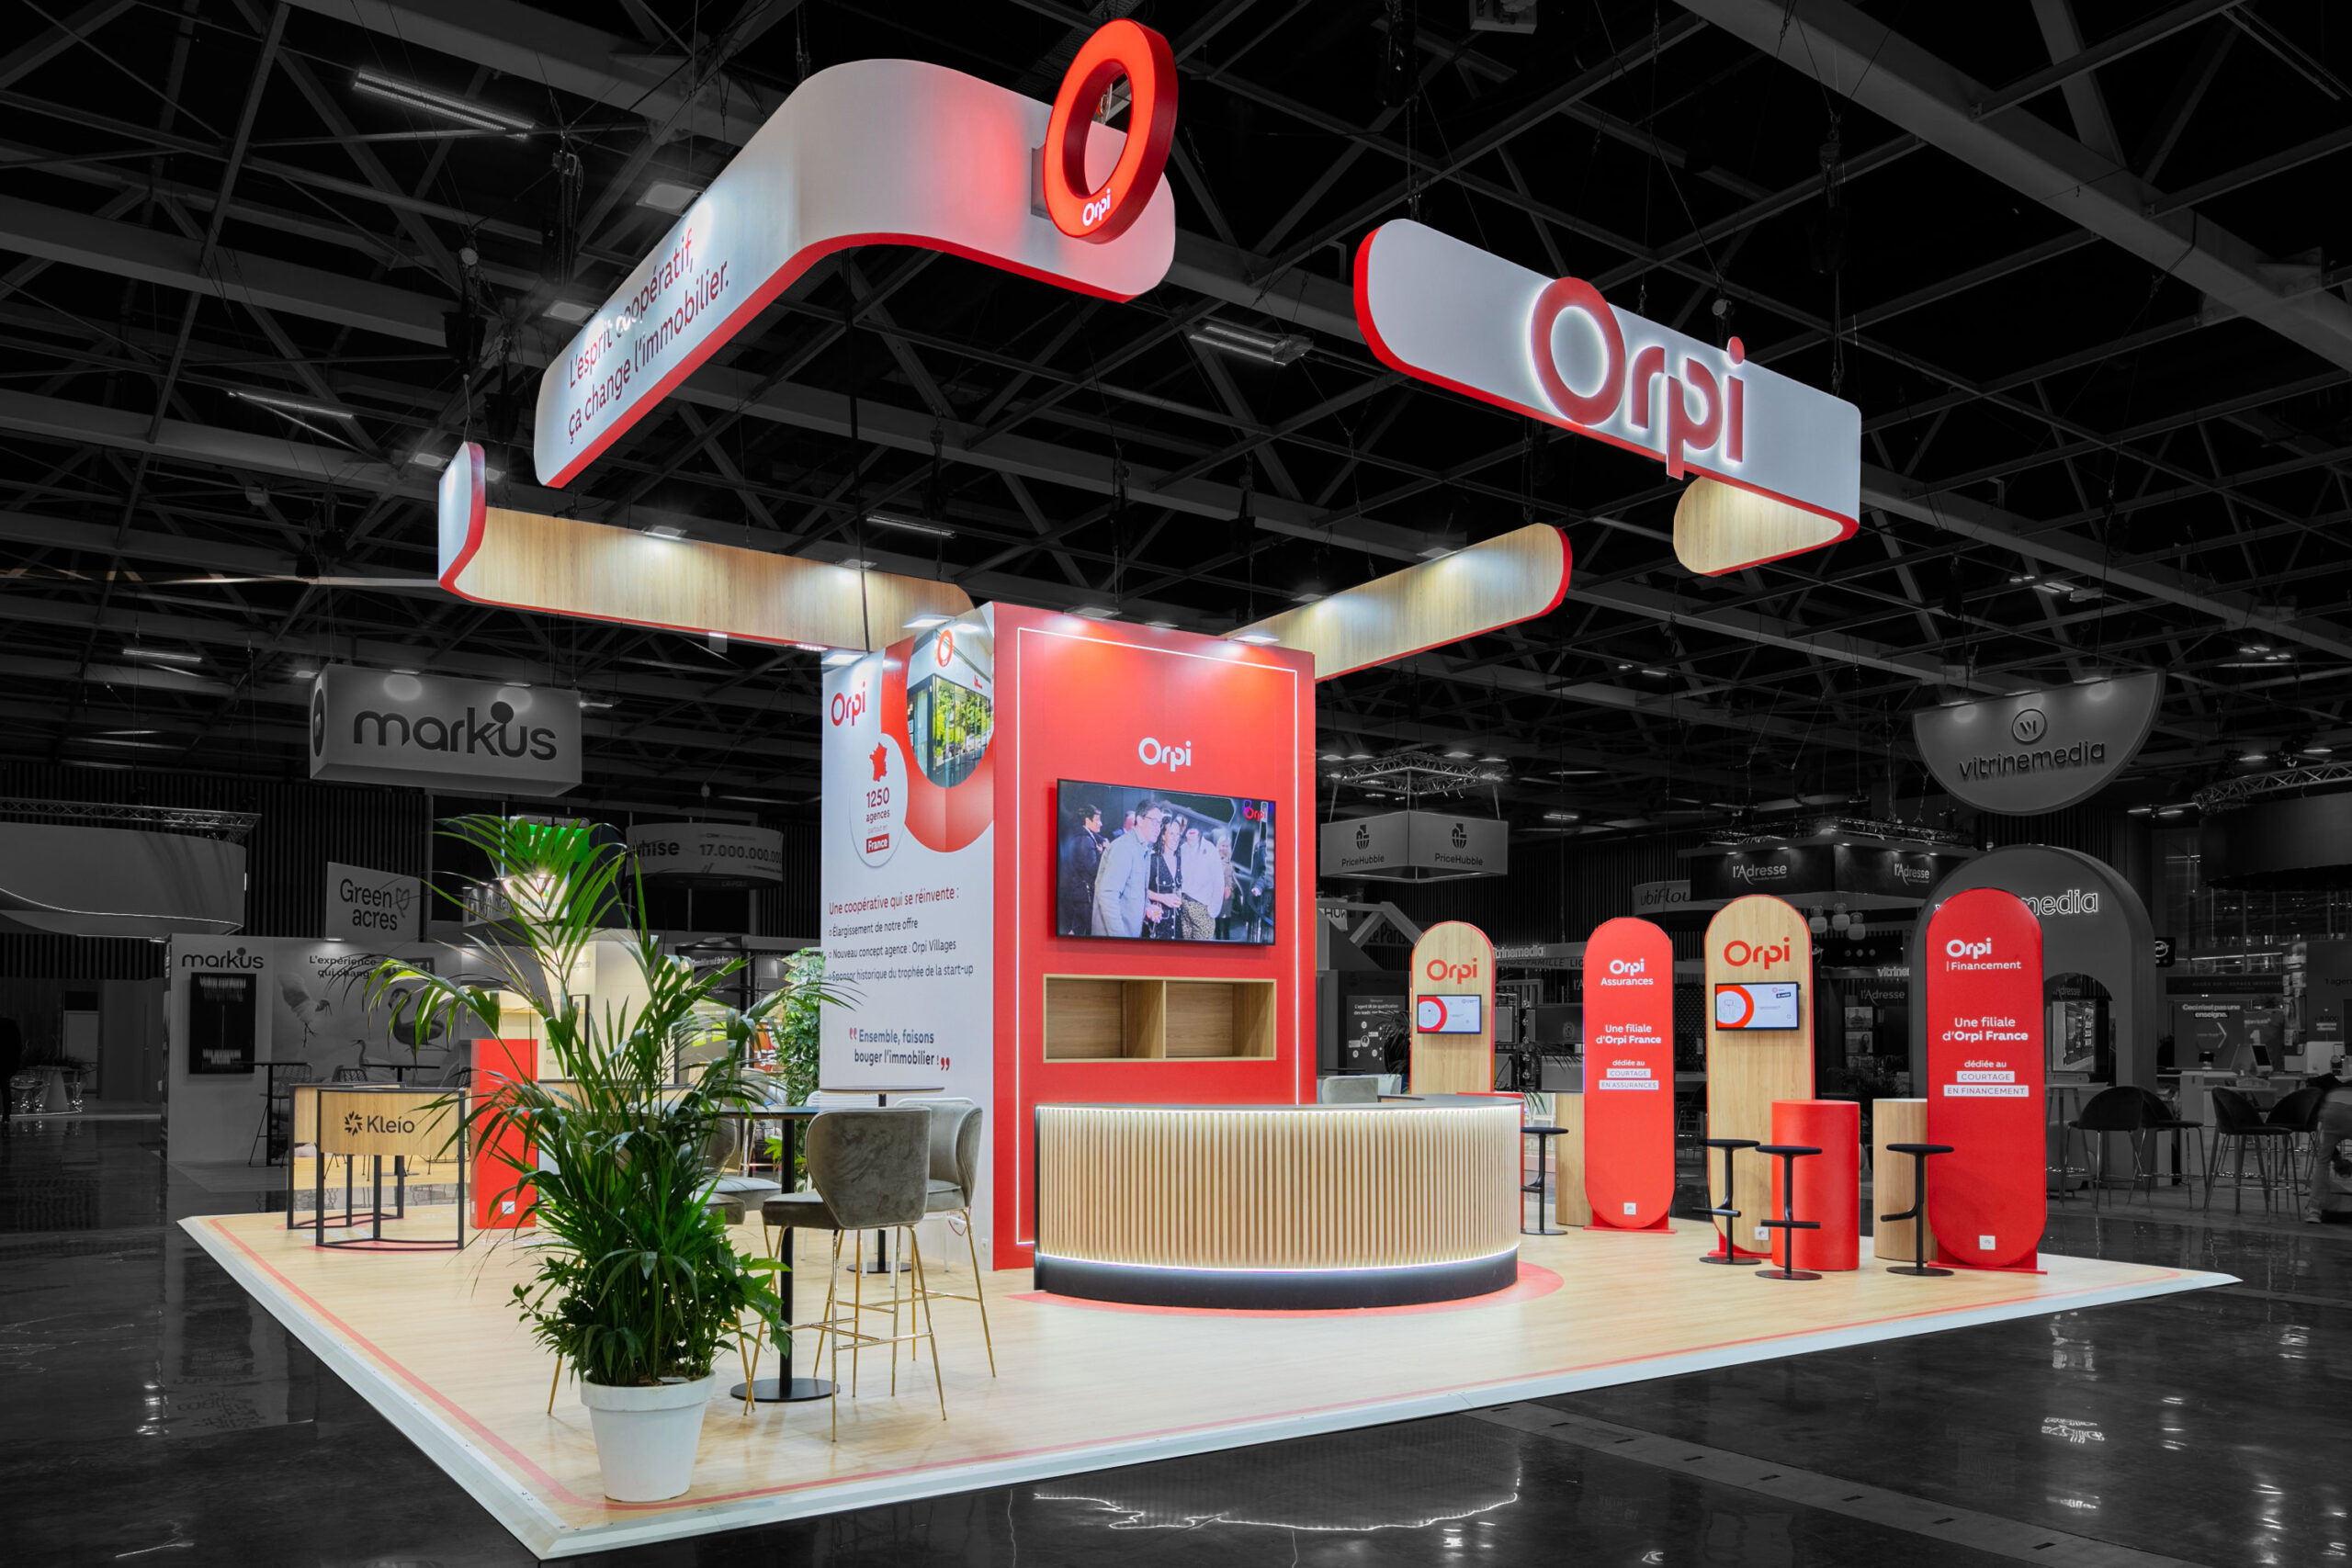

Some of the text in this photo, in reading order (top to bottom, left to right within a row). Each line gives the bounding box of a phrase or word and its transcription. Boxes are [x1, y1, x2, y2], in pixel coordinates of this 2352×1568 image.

[1082, 187, 1112, 227] Orpi
[615, 227, 695, 338] coopératif,
[568, 260, 729, 445] ça change l'immobilier.
[1530, 276, 1745, 480] Orpi
[831, 681, 866, 728] Orpi
[354, 701, 558, 761] markus
[1138, 737, 1192, 773] Orpi
[1959, 740, 2106, 779] vitrinemedia
[866, 786, 890, 808] 1250
[866, 809, 890, 824] agences
[867, 839, 888, 852] France
[1341, 854, 1385, 867] PriceHubble
[1434, 852, 1484, 866] PriceHubble
[339, 878, 393, 908] Green
[829, 902, 842, 915] Une
[843, 895, 888, 914] coopérative
[890, 891, 903, 909] qui
[904, 894, 913, 905] se
[915, 886, 955, 904] réinvente
[352, 908, 398, 931] acres
[832, 917, 919, 939] Élargissement de notre offre
[832, 948, 857, 959] Nouveau
[858, 945, 883, 960] concept
[885, 945, 908, 958] agence
[911, 941, 928, 954] Orpi
[929, 939, 956, 953] Villages
[1724, 937, 1790, 970] Orpi
[1946, 937, 1992, 960] Orpi
[181, 947, 265, 970] markus
[309, 954, 377, 966] L'expérience
[1609, 958, 1645, 976] Orpi
[1951, 961, 2021, 971] Financement
[317, 968, 334, 978] qui
[831, 964, 974, 982] Sponsor historique du trophée de la start-up
[1426, 958, 1477, 985] Orpi
[1600, 977, 1654, 987] Assurances
[1605, 1023, 1652, 1033] Une filiale
[1954, 1016, 2016, 1027] Une filiale
[858, 1029, 934, 1045] Ensemble, faisons
[1596, 1035, 1661, 1045] d'Orpi France
[1942, 1031, 2029, 1043] d'Orpi France
[854, 1049, 883, 1066] bouger
[884, 1049, 934, 1066] l'immobilier
[1963, 1060, 1994, 1068] dédiée
[1961, 1073, 2011, 1081] COURTAGE
[1947, 1087, 2026, 1095] EN FINANCEMENT
